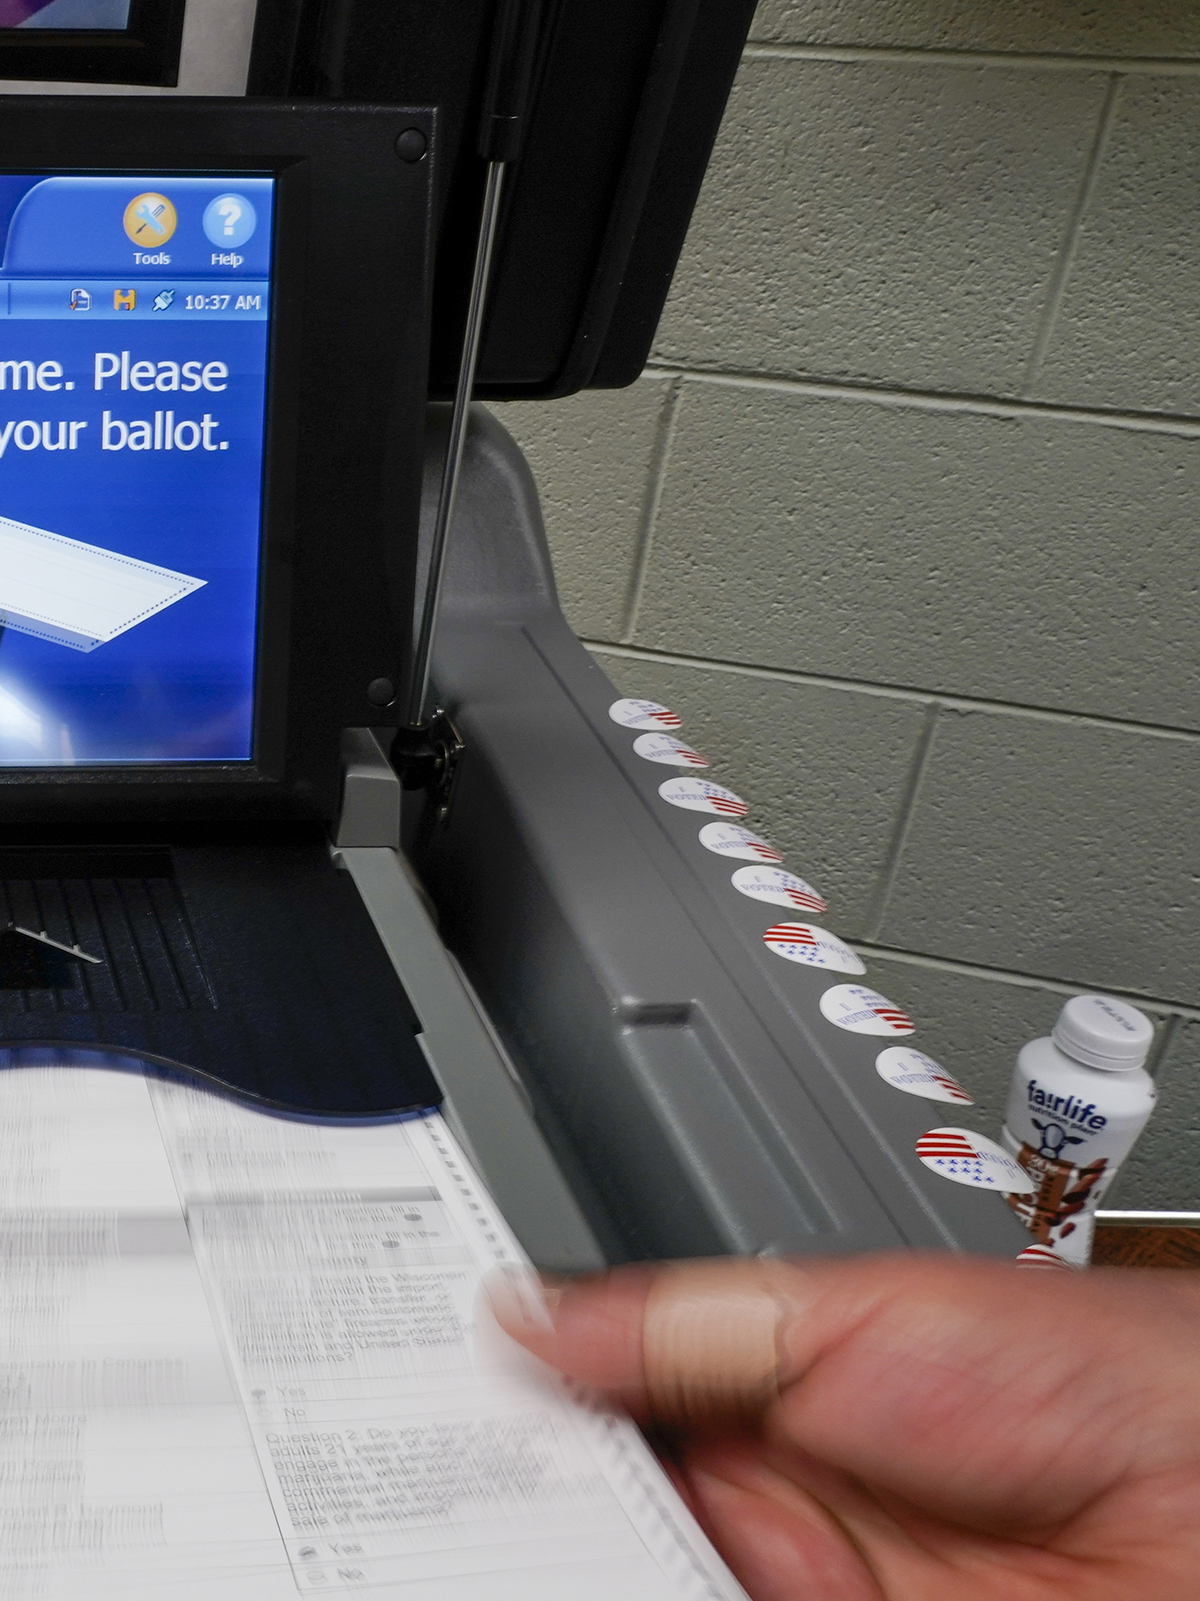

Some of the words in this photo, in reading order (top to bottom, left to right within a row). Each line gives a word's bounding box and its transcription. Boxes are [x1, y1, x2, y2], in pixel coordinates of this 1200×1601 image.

[133, 252, 172, 265] Tools
[211, 253, 245, 269] Help
[185, 295, 231, 310] 10:37
[234, 295, 261, 310] AM
[93, 350, 230, 392] Please
[101, 410, 230, 452] ballot.
[36, 1412, 87, 1424] Moore
[284, 1407, 305, 1418] No
[265, 1431, 341, 1444] Question
[367, 1427, 392, 1440] Do
[270, 1445, 320, 1457] adults
[326, 1444, 345, 1456] 21
[274, 1459, 338, 1471] engage
